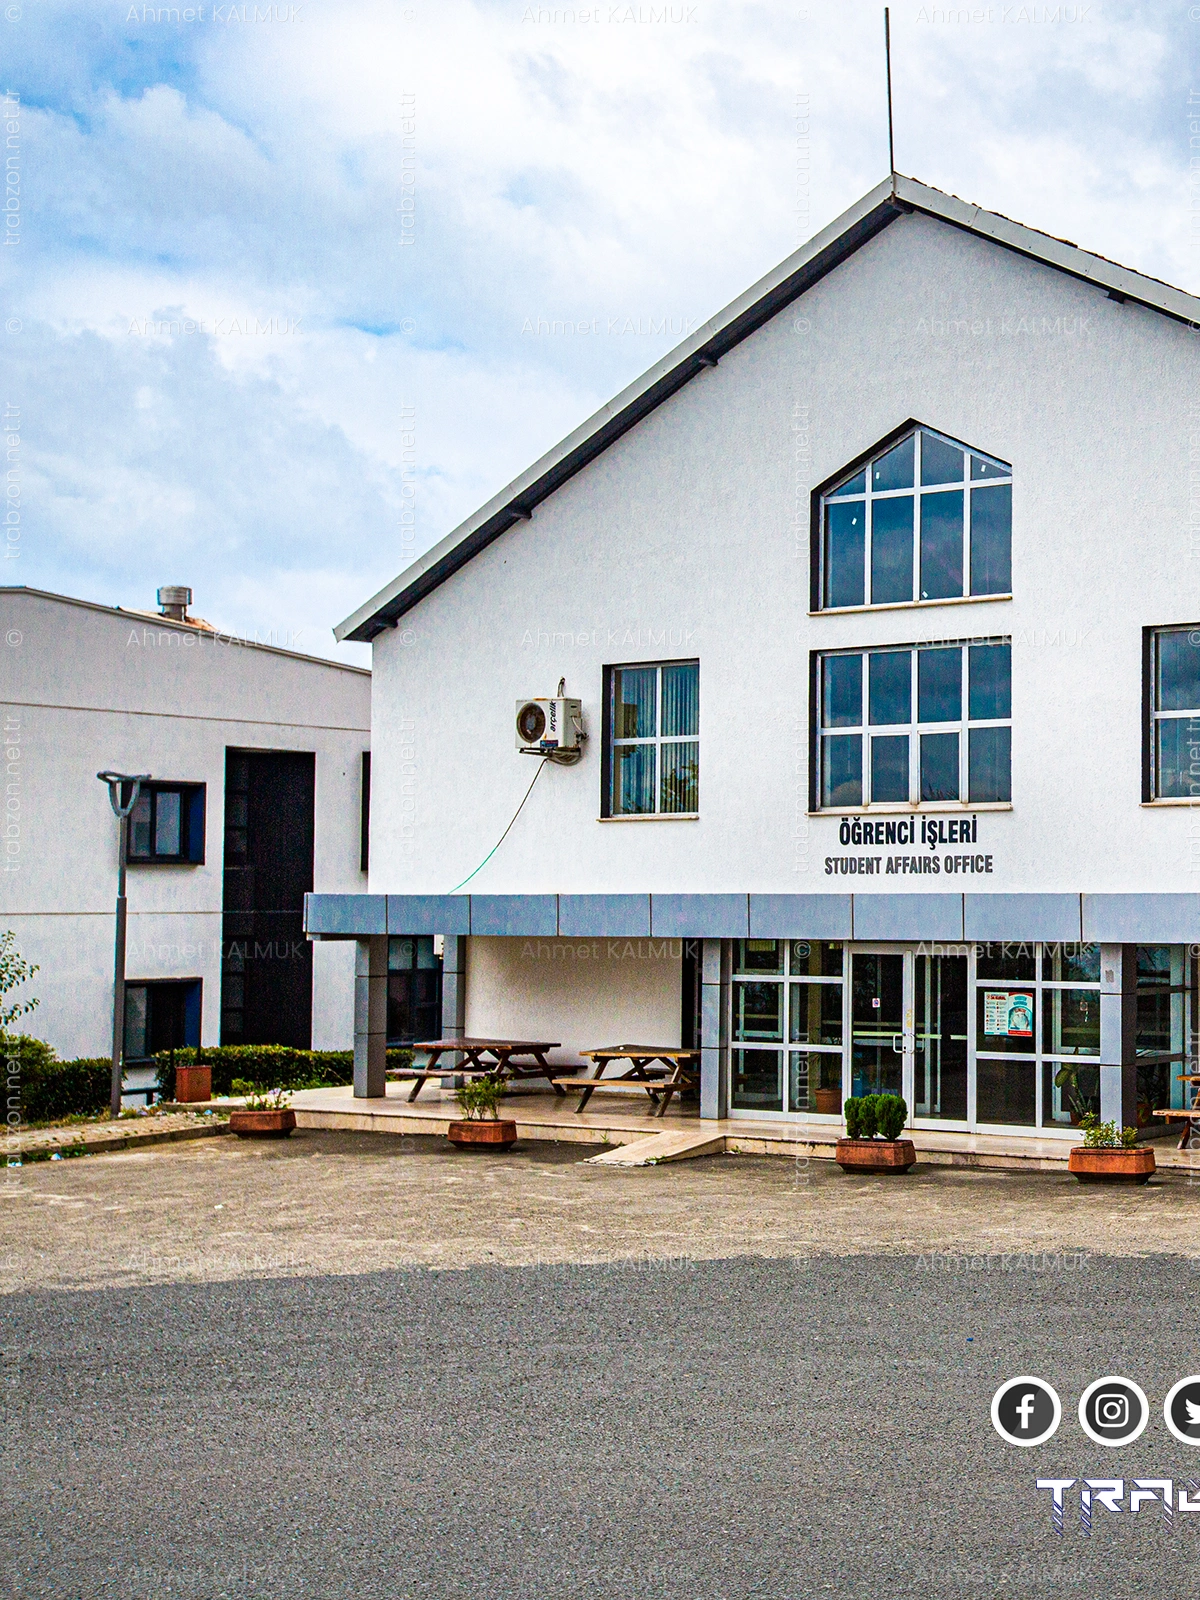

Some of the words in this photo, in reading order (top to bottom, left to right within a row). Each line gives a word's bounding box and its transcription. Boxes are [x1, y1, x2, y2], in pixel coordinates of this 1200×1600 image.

[838, 815, 915, 846] ÖĞRENCİ
[921, 814, 977, 850] İŞLERİ
[824, 856, 882, 875] STUDENT
[885, 855, 940, 875] AFFAIRS
[944, 854, 993, 874] OFFICE
